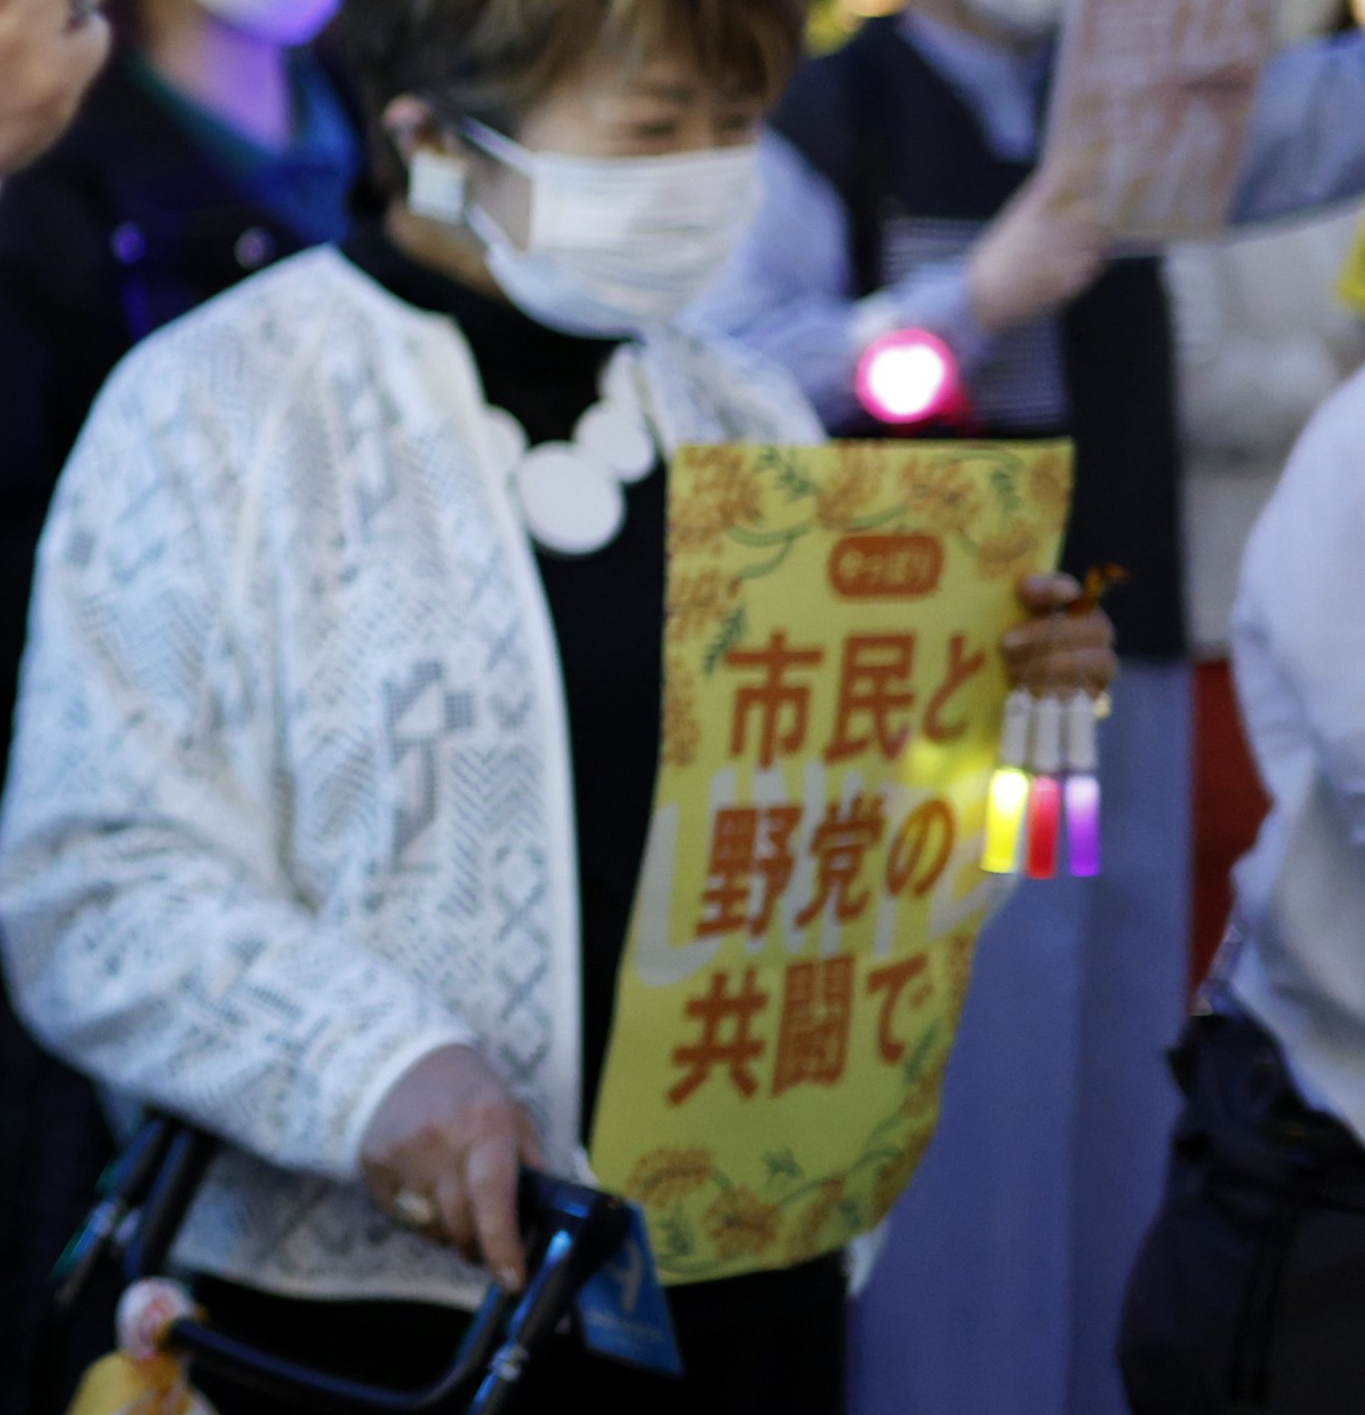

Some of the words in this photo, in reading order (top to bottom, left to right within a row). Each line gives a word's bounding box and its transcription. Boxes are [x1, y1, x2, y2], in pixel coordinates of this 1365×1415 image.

[726, 629, 988, 773] 市民と
[694, 793, 957, 941] 野党の
[666, 953, 934, 1109] 共闘で
